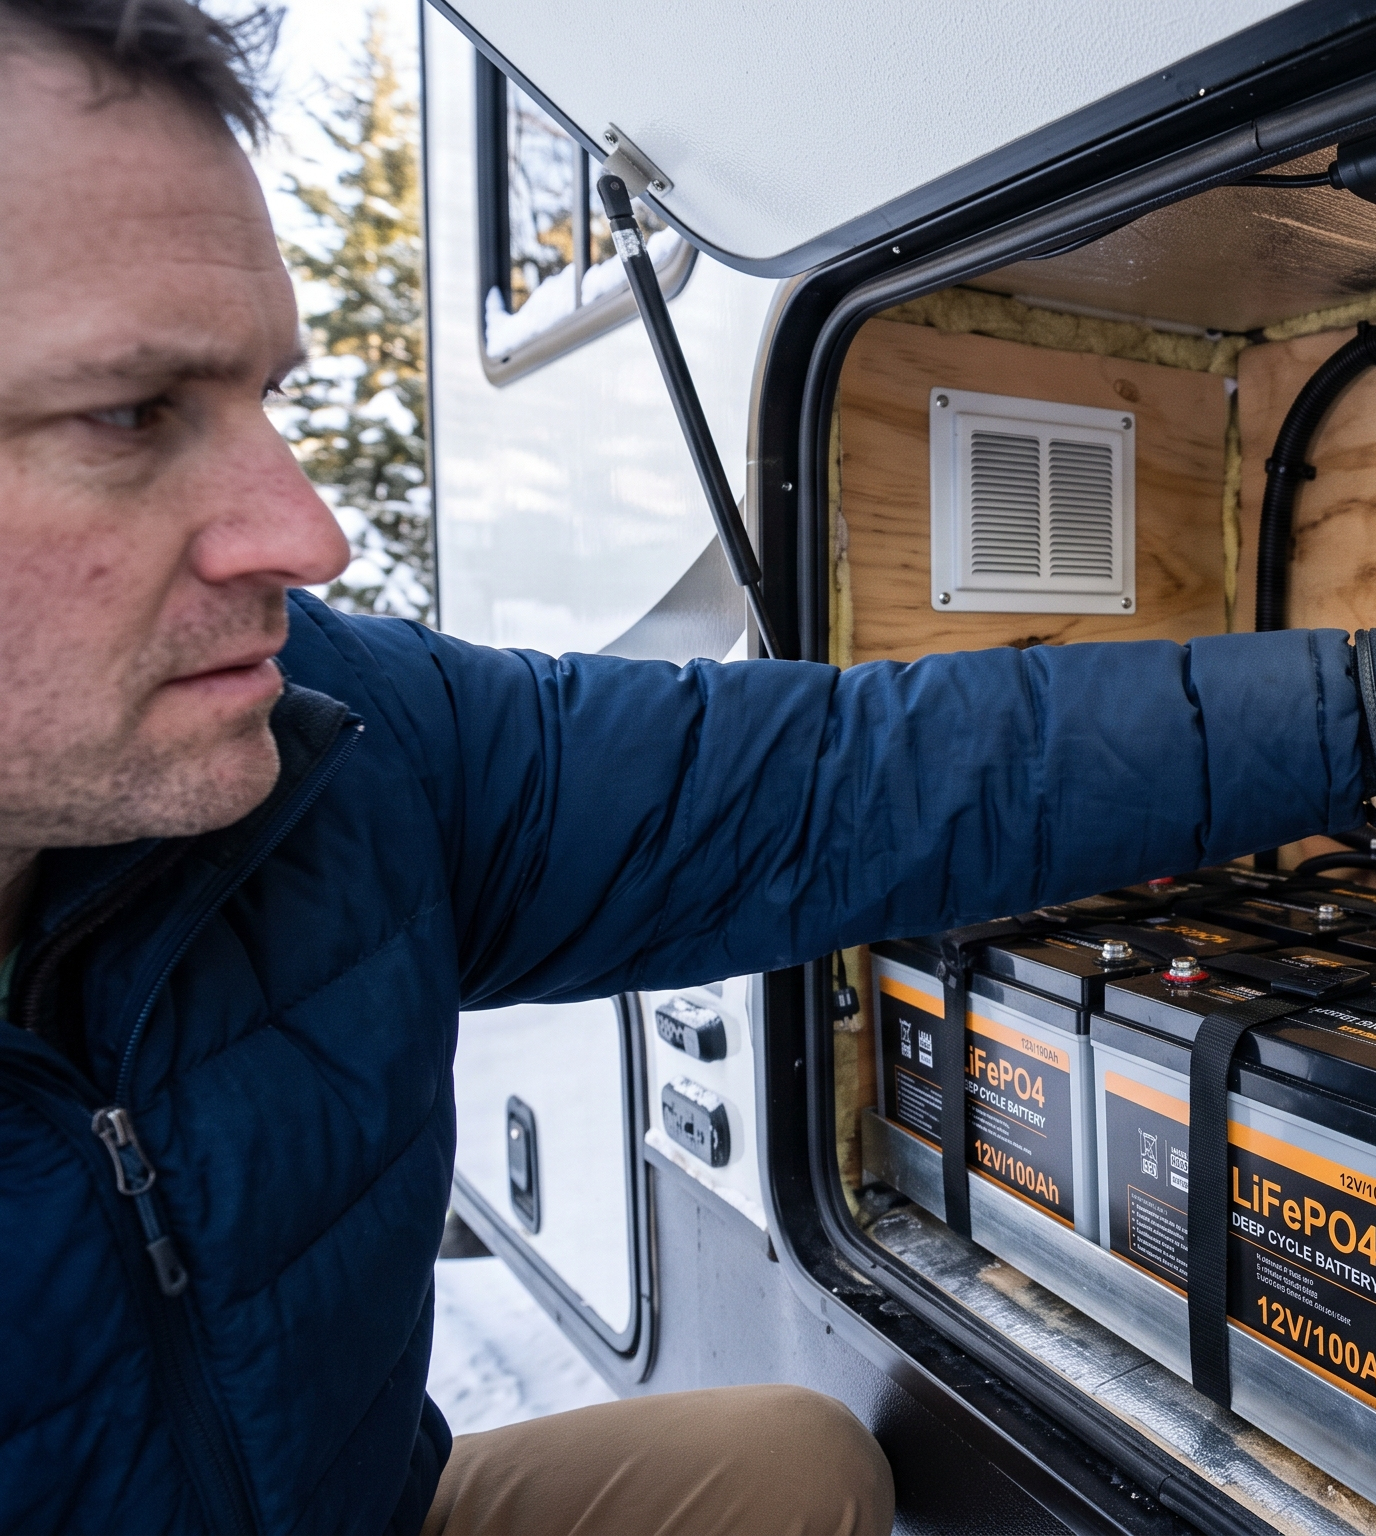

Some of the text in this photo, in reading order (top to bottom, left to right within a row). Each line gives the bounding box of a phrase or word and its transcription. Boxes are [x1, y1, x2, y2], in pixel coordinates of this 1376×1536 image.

[965, 1045, 1046, 1109] iFePO4
[979, 1086, 1007, 1110] CYCLE
[1007, 1099, 1046, 1129] BATTERY
[974, 1139, 1060, 1205] 12V/100Ah
[1232, 1211, 1265, 1238] DEEP
[1267, 1229, 1312, 1262] CYCLE
